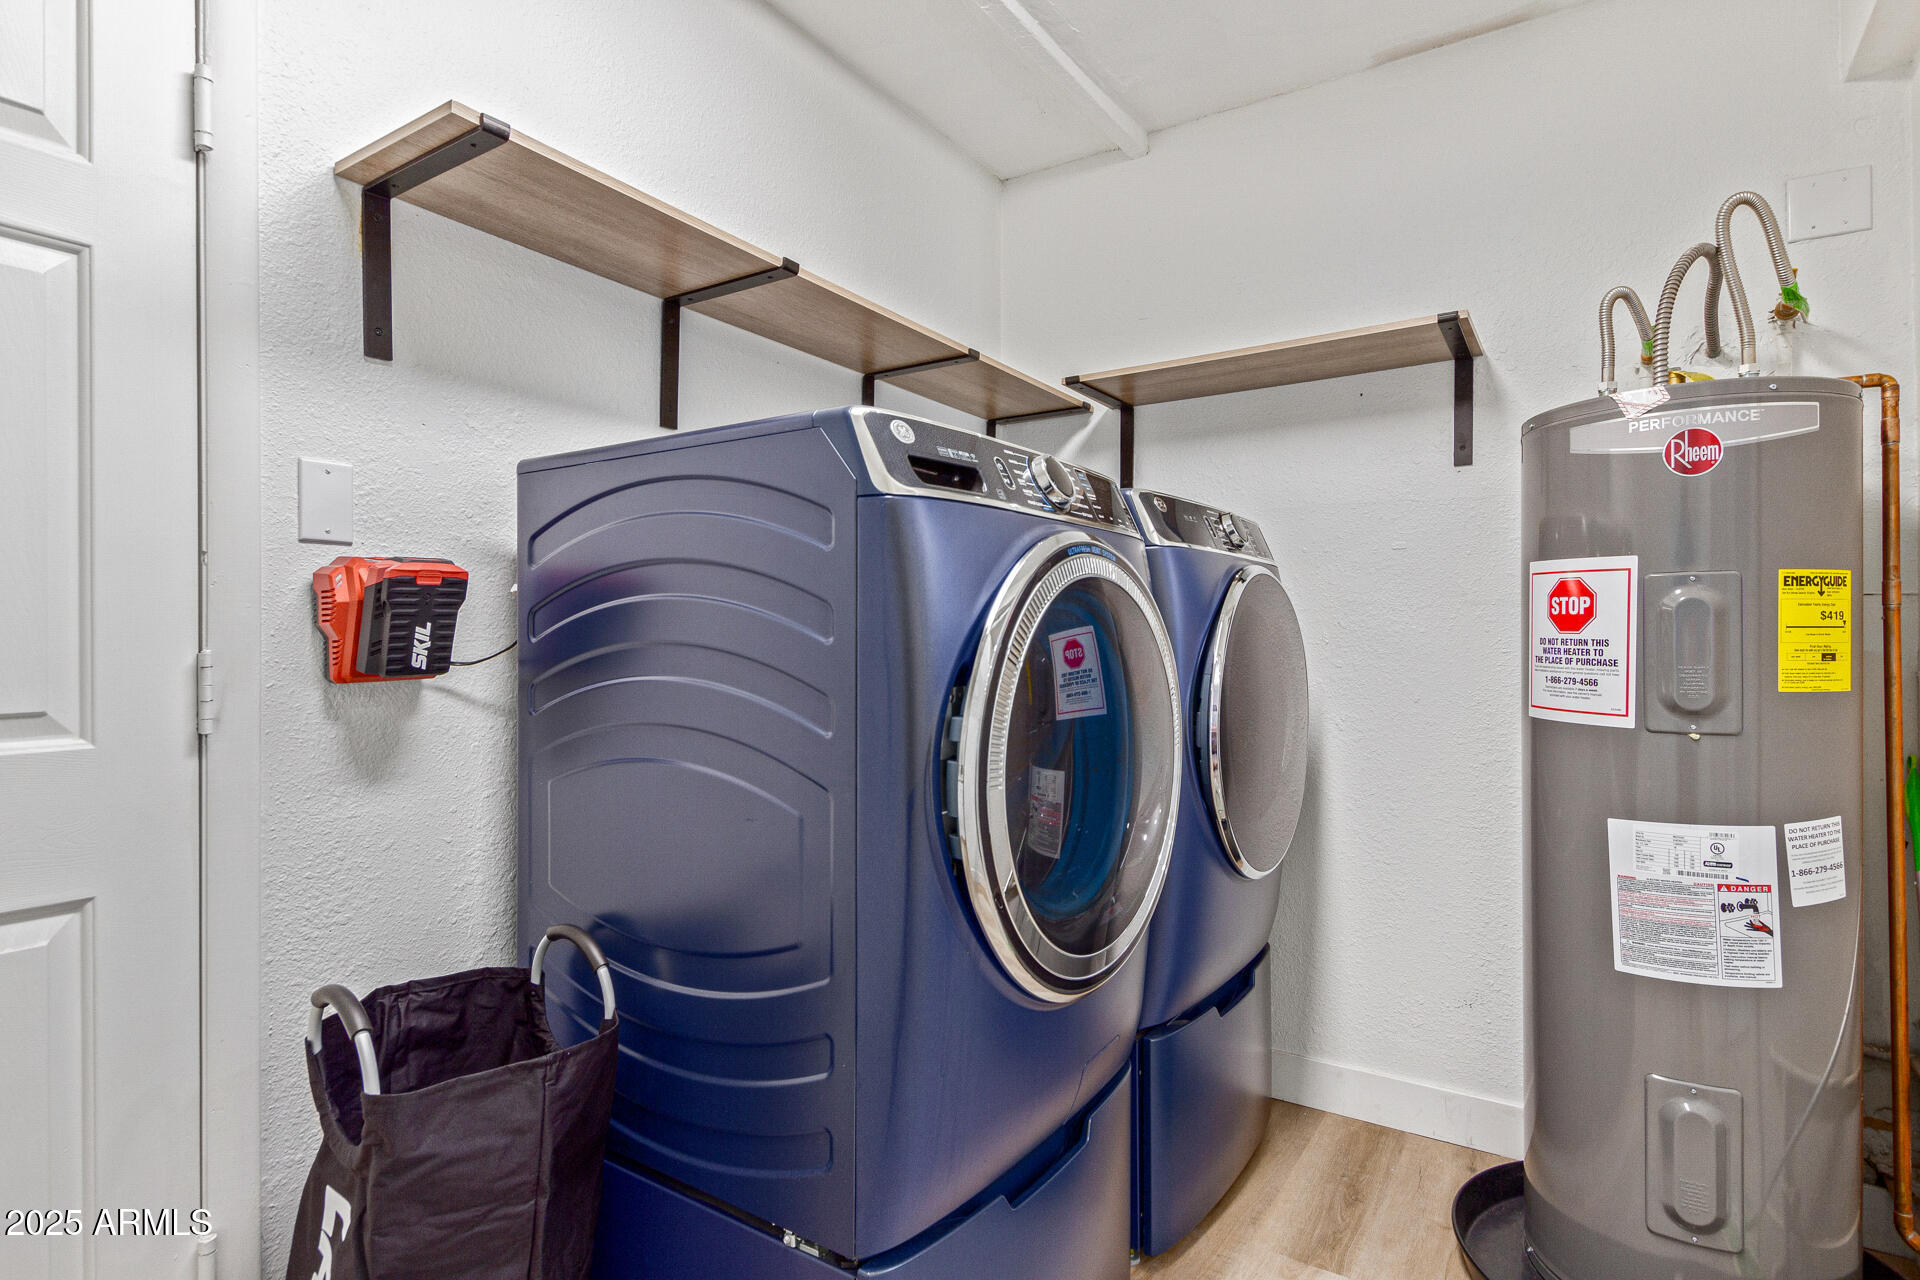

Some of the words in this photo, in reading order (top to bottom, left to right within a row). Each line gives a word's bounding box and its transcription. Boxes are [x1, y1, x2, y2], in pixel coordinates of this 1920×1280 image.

[1628, 409, 1761, 433] PERFORMANCE
[1670, 430, 1721, 469] Rheem
[1551, 596, 1591, 615] STOP
[1820, 610, 1844, 620] $419
[411, 621, 432, 670] SKIL
[1539, 637, 1547, 646] DO
[1548, 638, 1559, 646] NOT
[1560, 638, 1588, 647] RETURN
[1591, 639, 1610, 648] THIS
[1542, 647, 1562, 655] WATER
[1563, 648, 1591, 656] HEATER
[1535, 656, 1544, 664] THE
[1544, 656, 1563, 665] PLACE
[1564, 658, 1574, 666] OF
[1576, 658, 1619, 668] PURCHASE
[1545, 676, 1599, 687] 1-866-279-4566
[1799, 826, 1810, 834] NOT
[1811, 824, 1831, 832] RETURN
[1808, 832, 1827, 840] HEATER
[1791, 861, 1844, 878] 1-866-279-4566
[1730, 884, 1769, 892] DANGER
